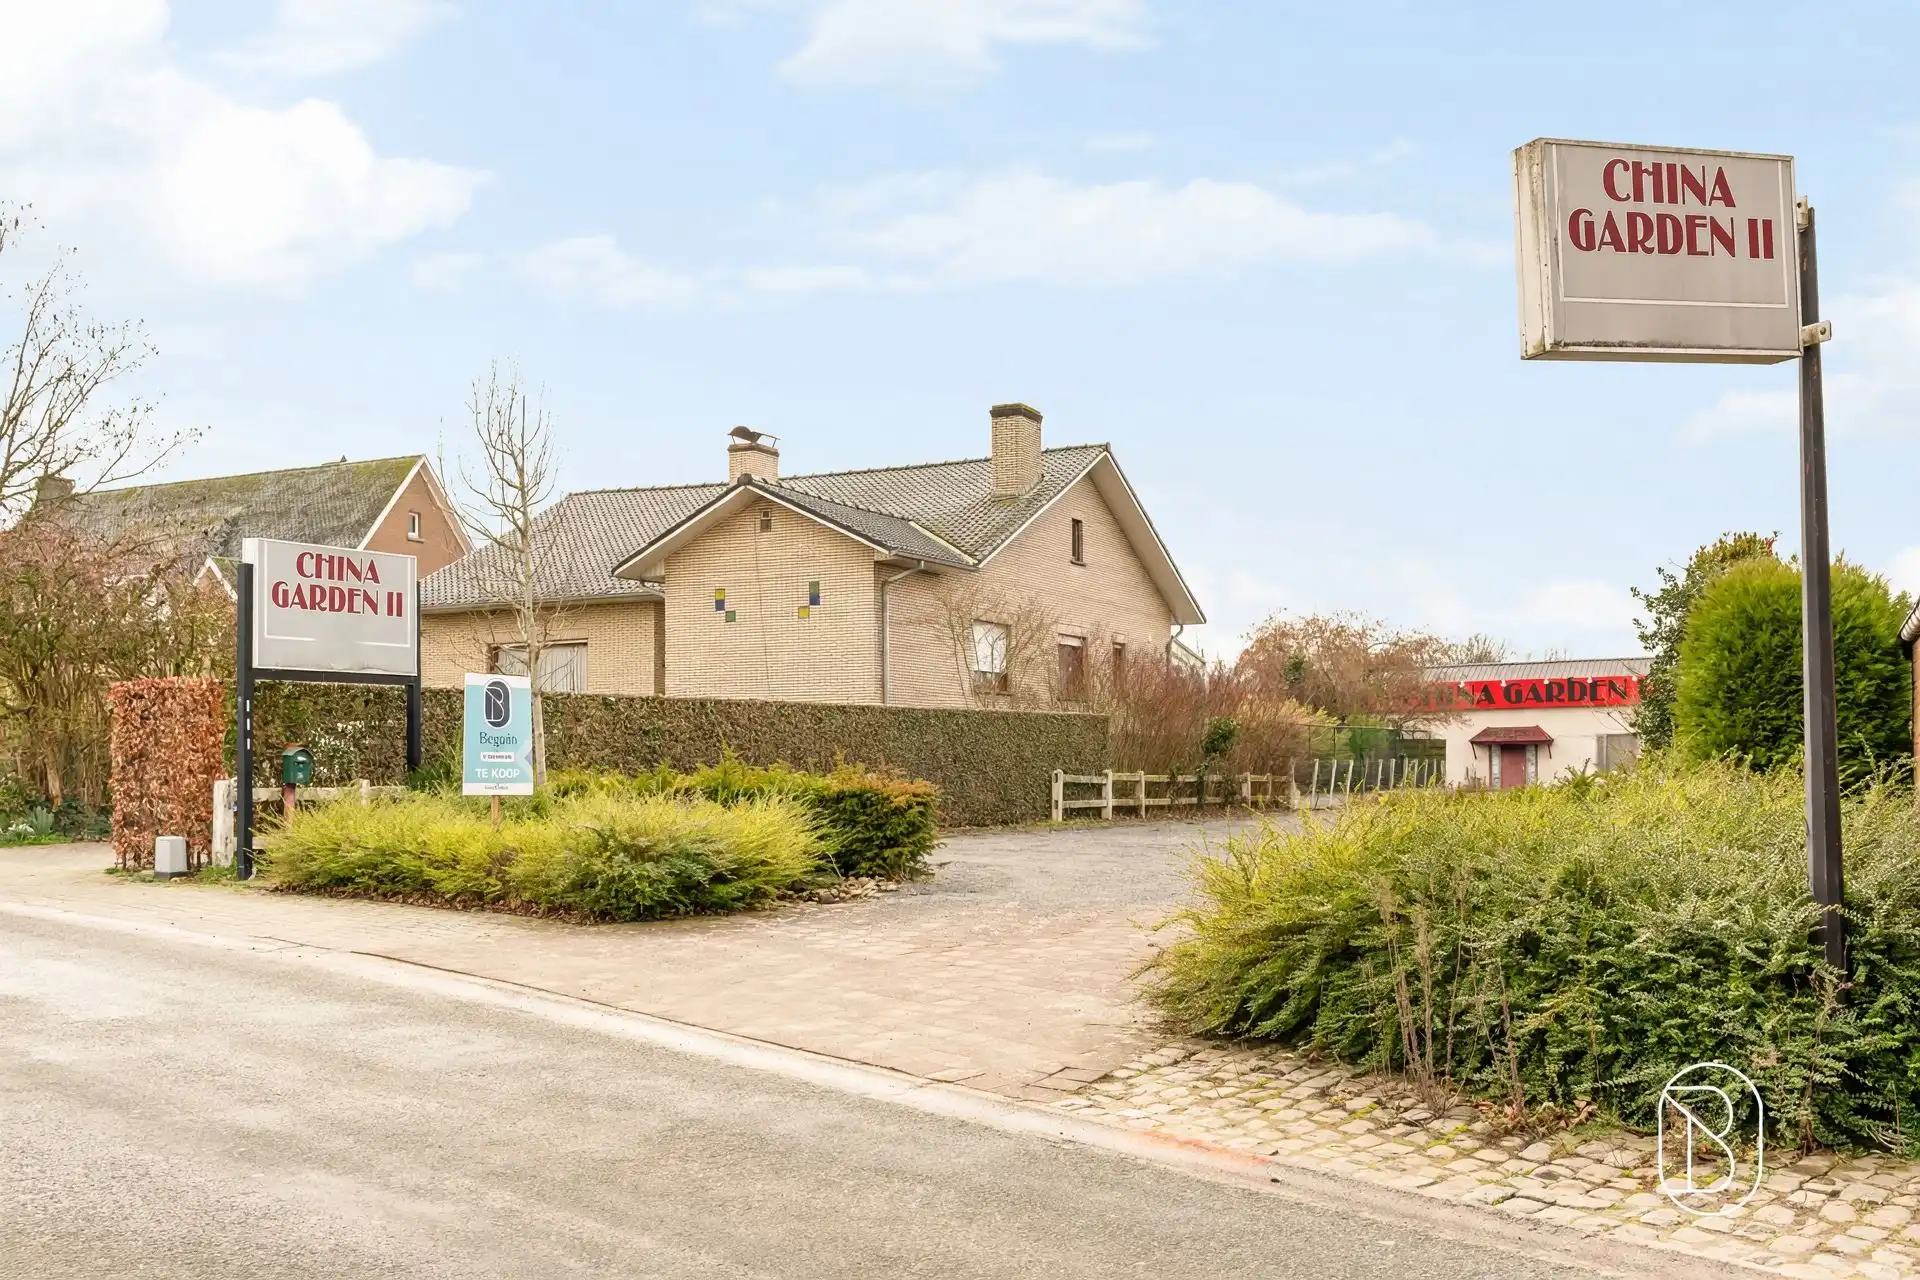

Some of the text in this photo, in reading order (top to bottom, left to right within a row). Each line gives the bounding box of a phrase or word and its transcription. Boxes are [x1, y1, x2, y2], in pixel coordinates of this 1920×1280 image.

[1602, 158, 1736, 207] CHINA
[1568, 208, 1774, 259] GARDEN II
[296, 552, 380, 584] CHINA
[272, 581, 403, 617] GARDEN II
[1503, 677, 1628, 705] GARDEN
[475, 768, 521, 779] TE KOOP
